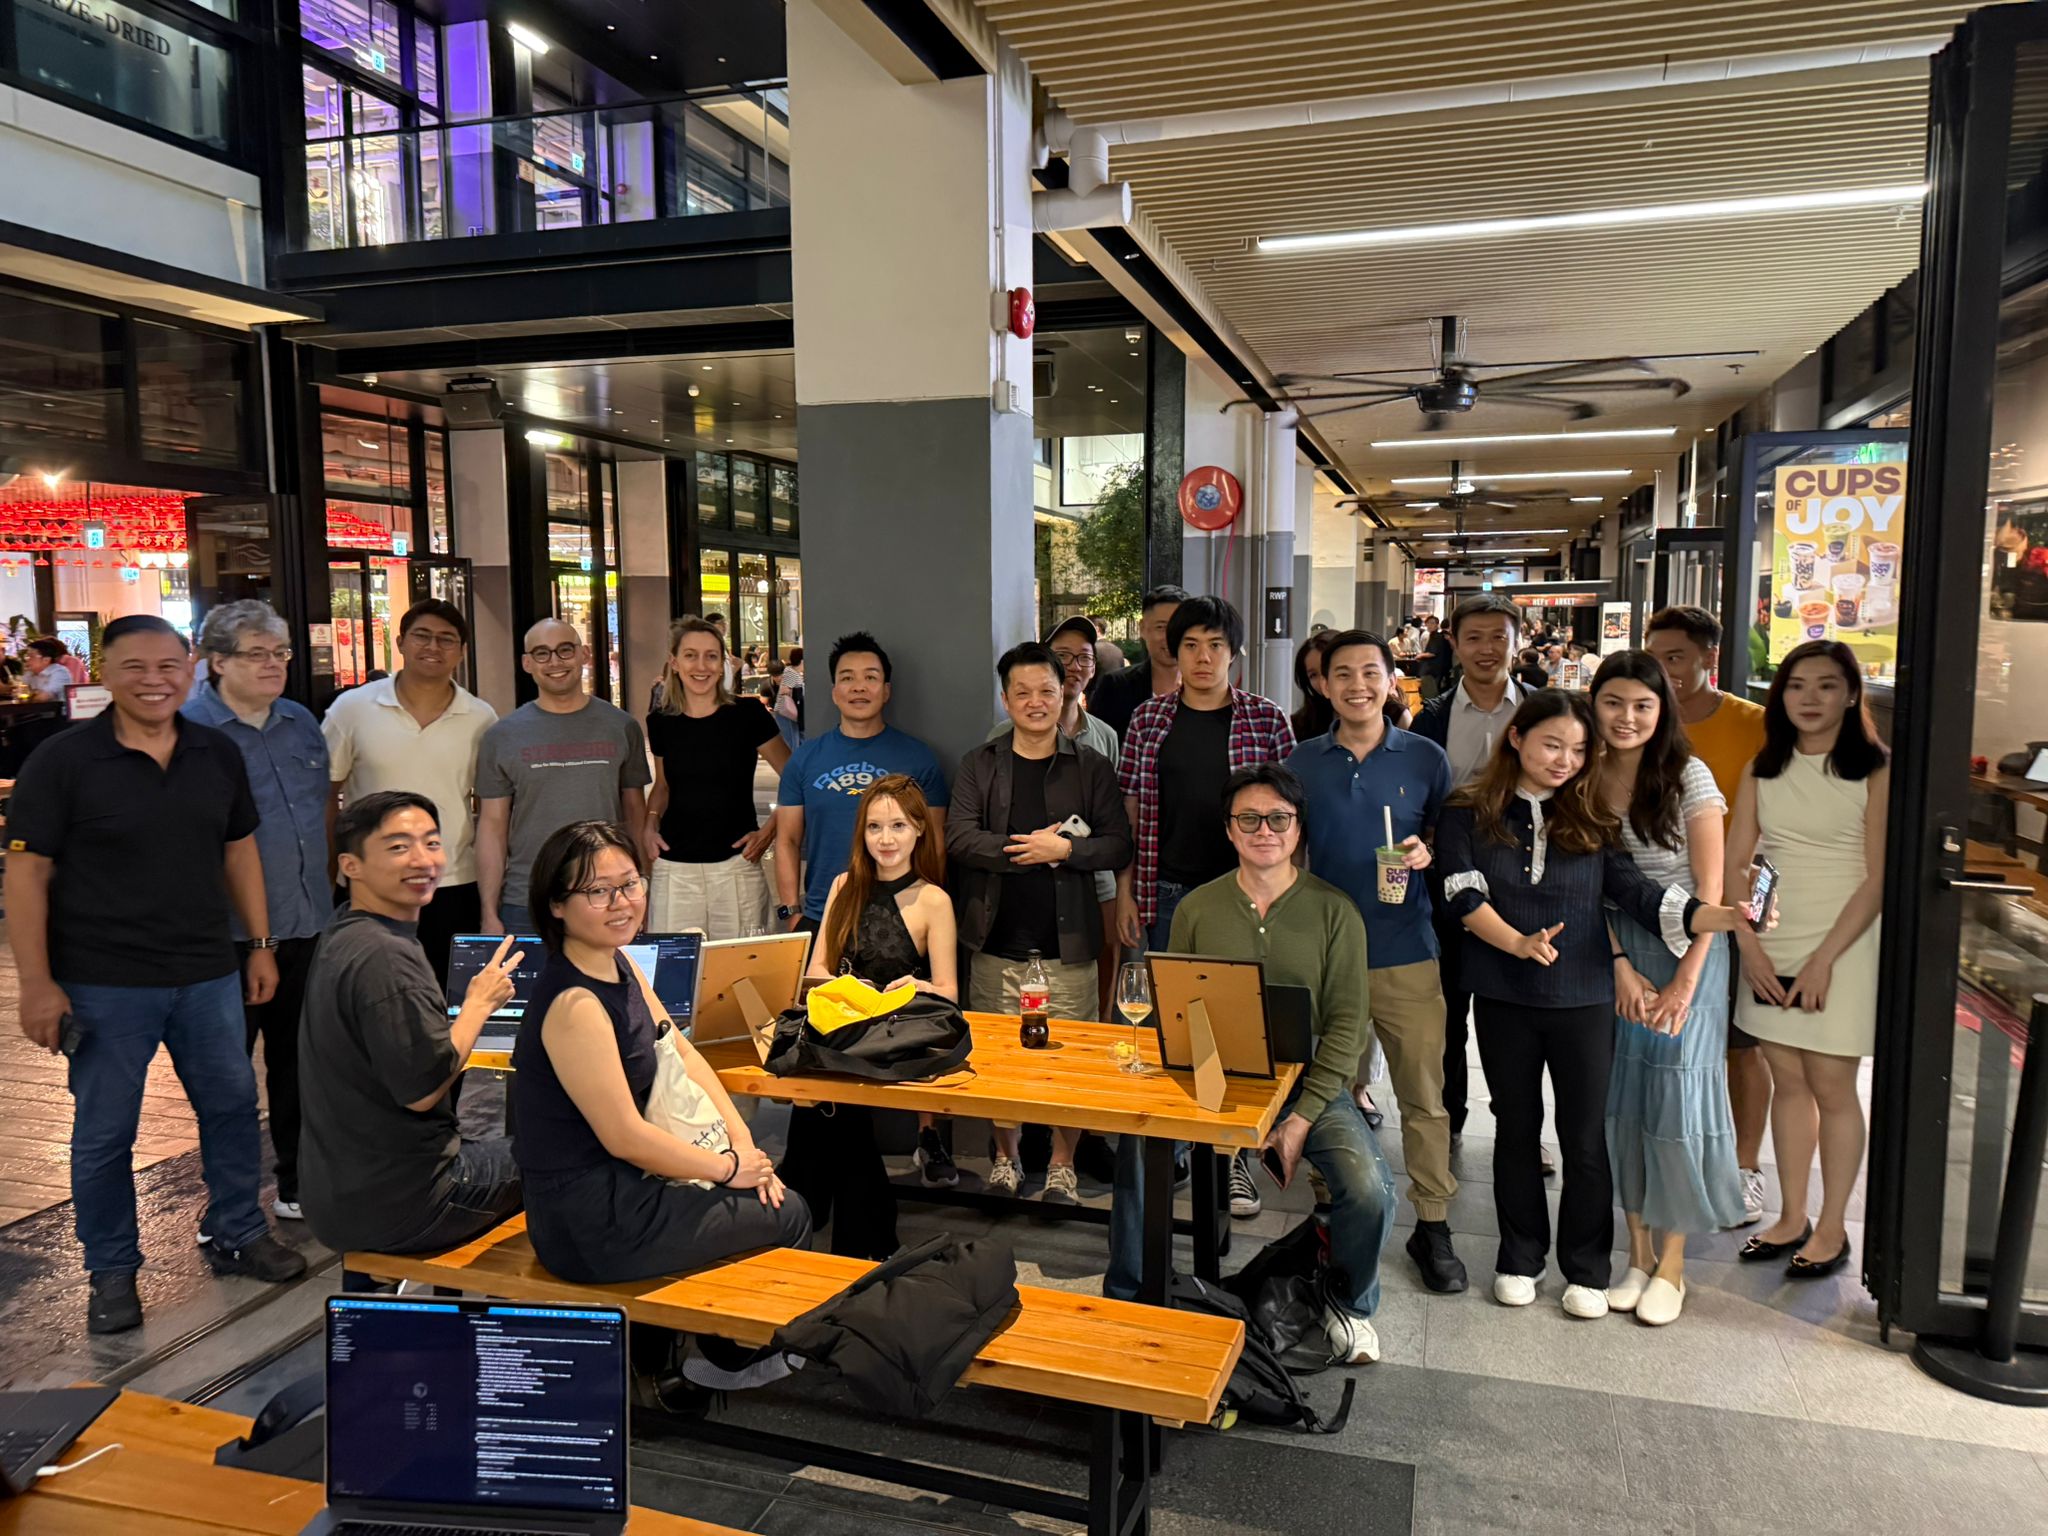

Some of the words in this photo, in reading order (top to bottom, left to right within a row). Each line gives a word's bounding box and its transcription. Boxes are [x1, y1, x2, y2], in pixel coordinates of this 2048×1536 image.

[1785, 466, 1901, 498] CUPS
[1785, 495, 1904, 535] JOY
[1786, 499, 1802, 511] OF
[1269, 591, 1287, 600] RWP
[812, 761, 889, 790] Reebo
[827, 772, 873, 792] 189
